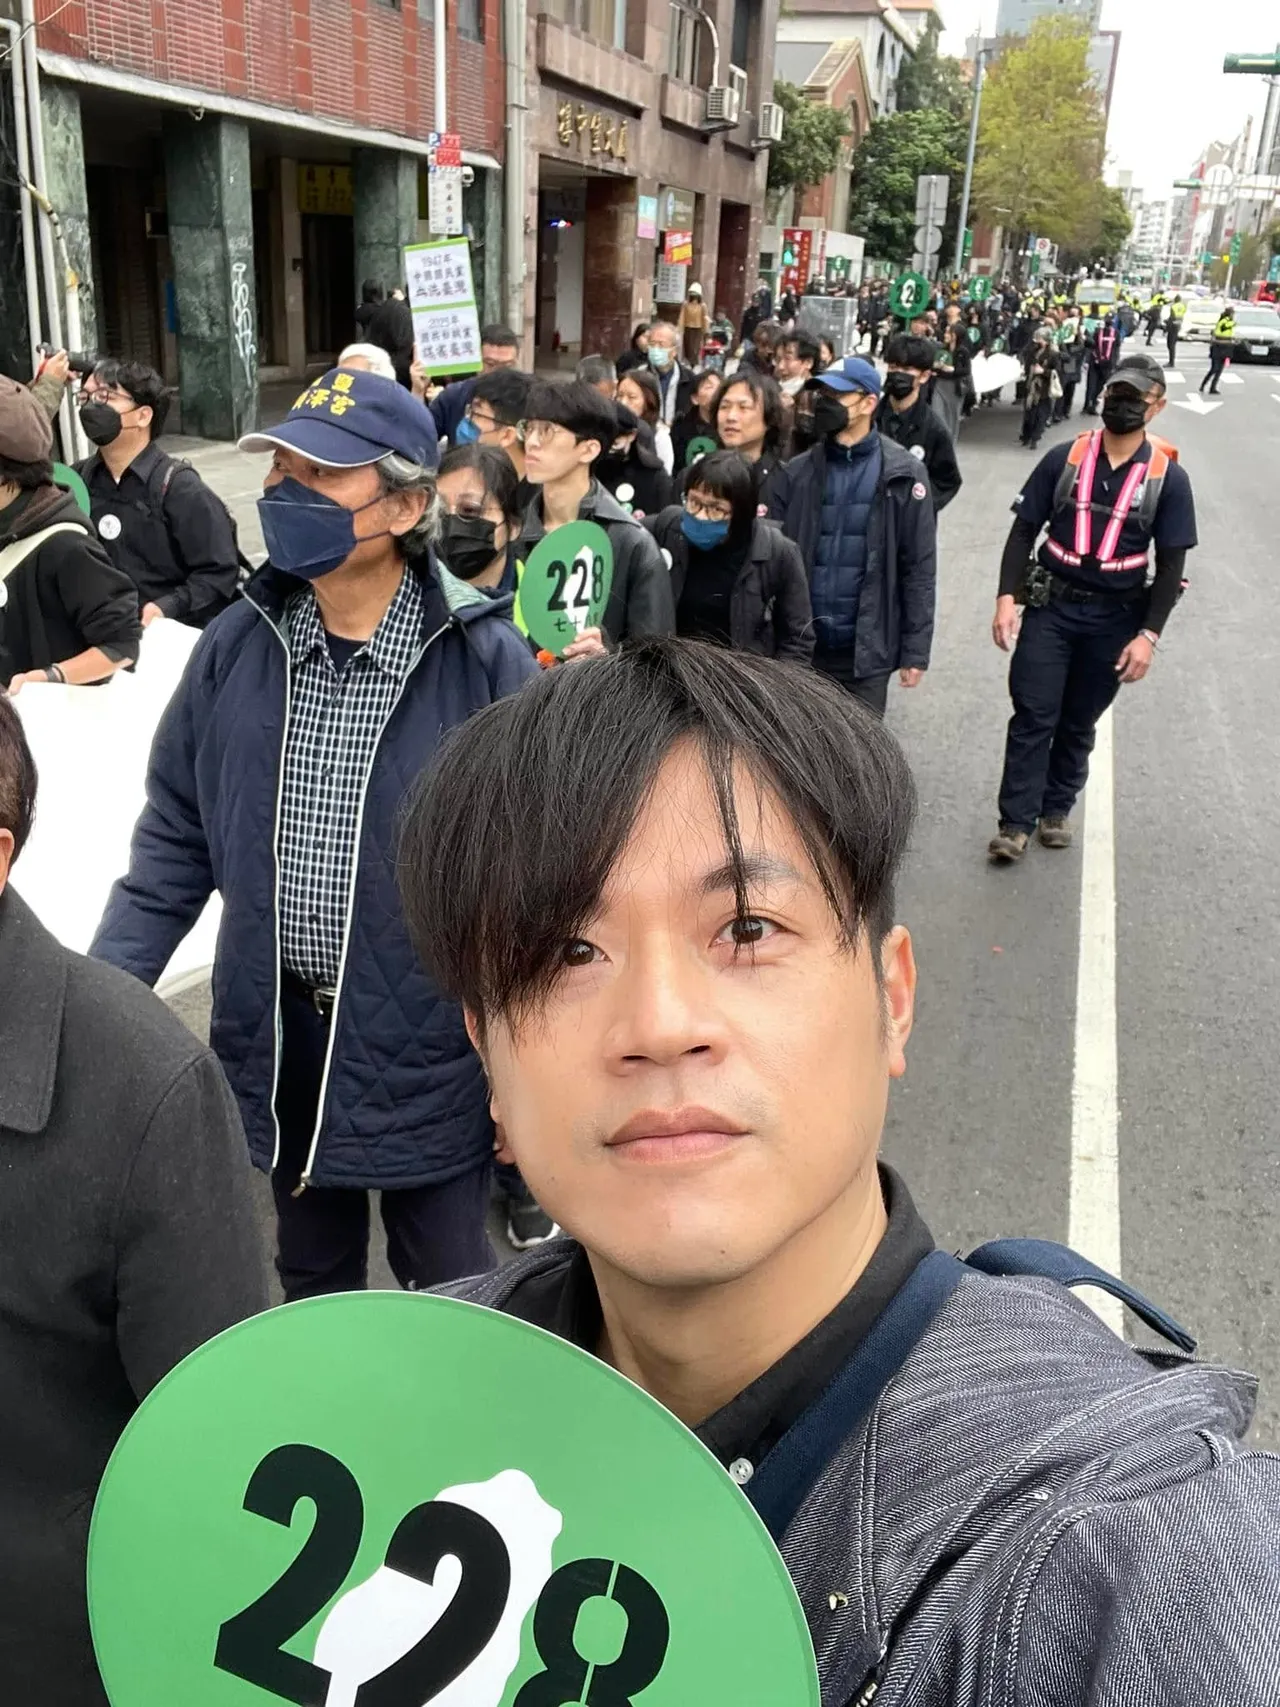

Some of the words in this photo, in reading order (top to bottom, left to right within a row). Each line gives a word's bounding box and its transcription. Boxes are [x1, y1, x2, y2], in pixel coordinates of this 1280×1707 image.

[421, 253, 454, 267] 1947年
[310, 373, 355, 394] 鹽
[546, 554, 605, 612] 228
[214, 1443, 670, 1707] 228
